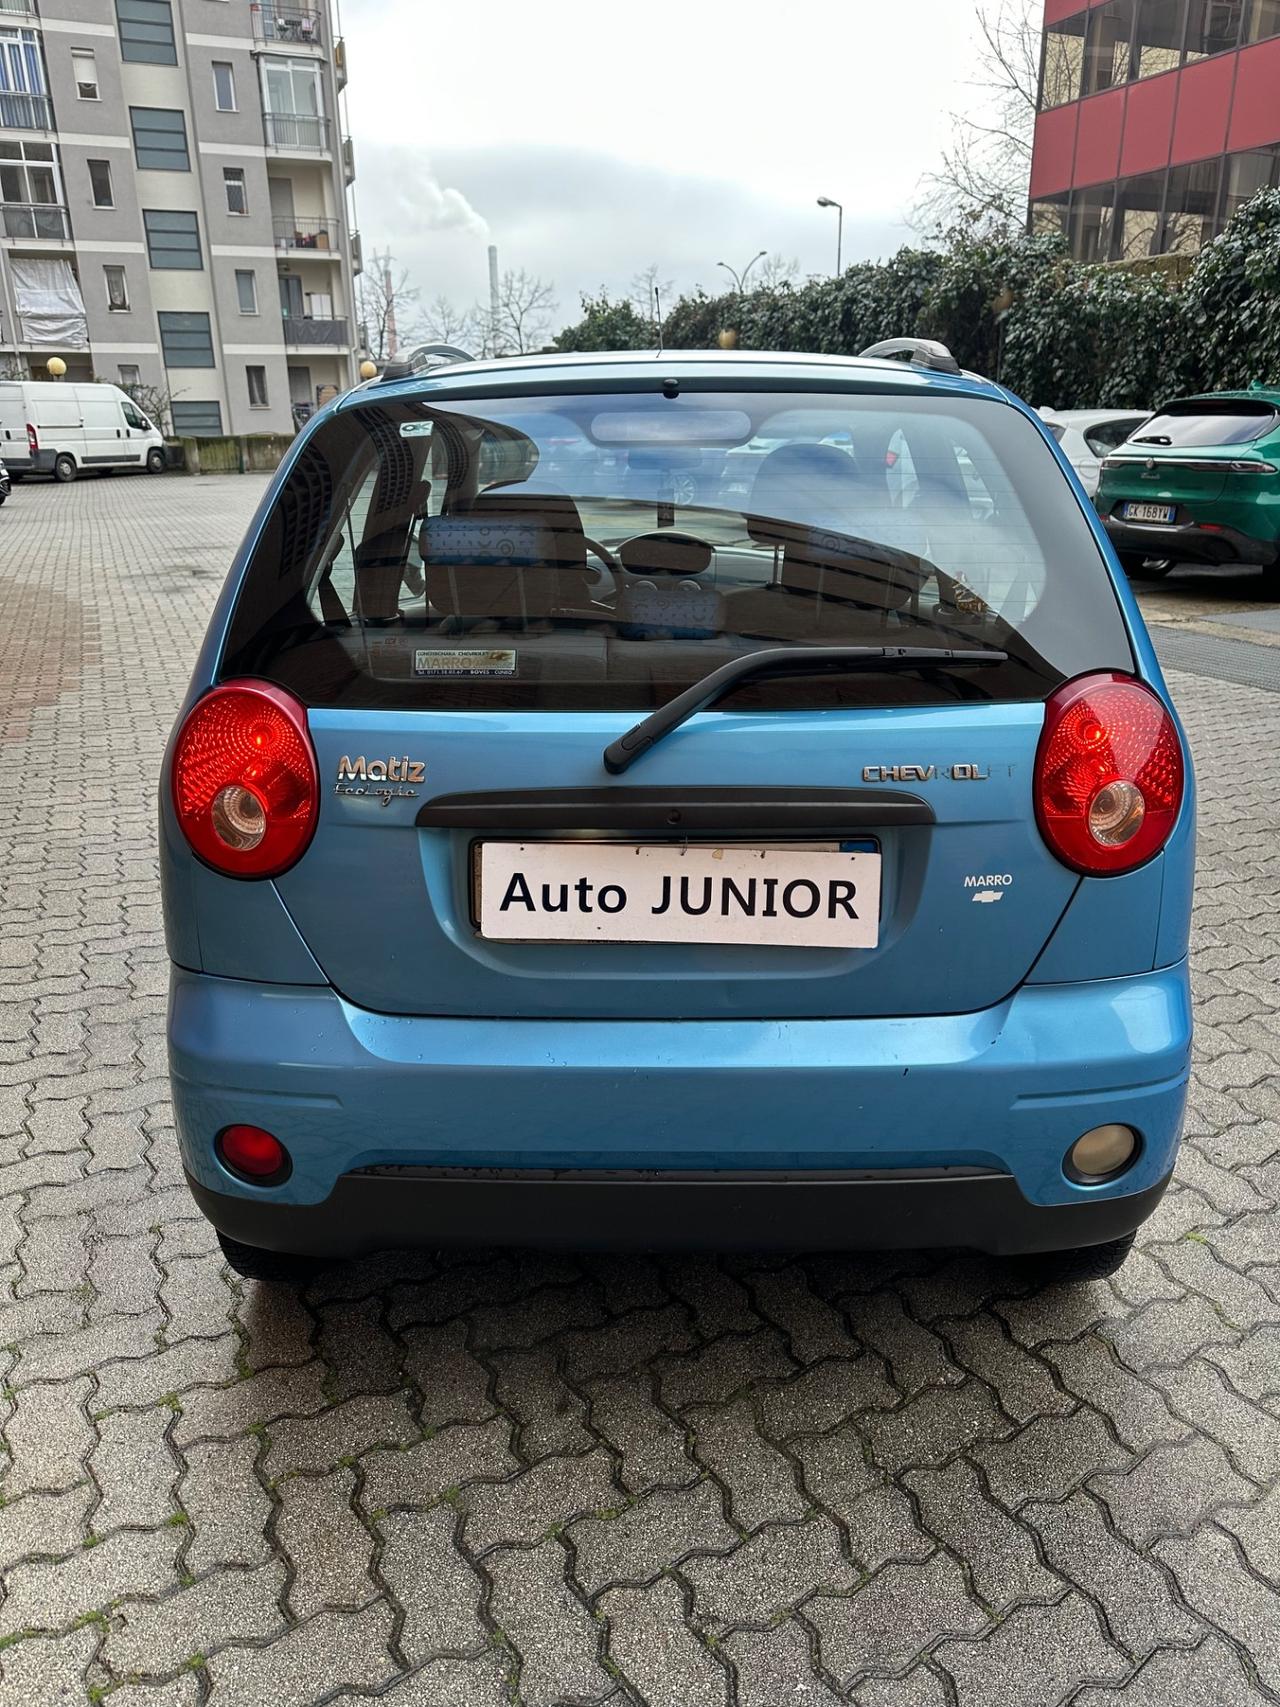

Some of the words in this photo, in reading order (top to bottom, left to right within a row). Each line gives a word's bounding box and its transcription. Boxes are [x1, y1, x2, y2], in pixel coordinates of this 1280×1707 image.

[338, 755, 426, 783] Matiz
[964, 874, 1012, 887] MARRO
[499, 872, 628, 914] Auto
[651, 875, 860, 920] JUNIOR
